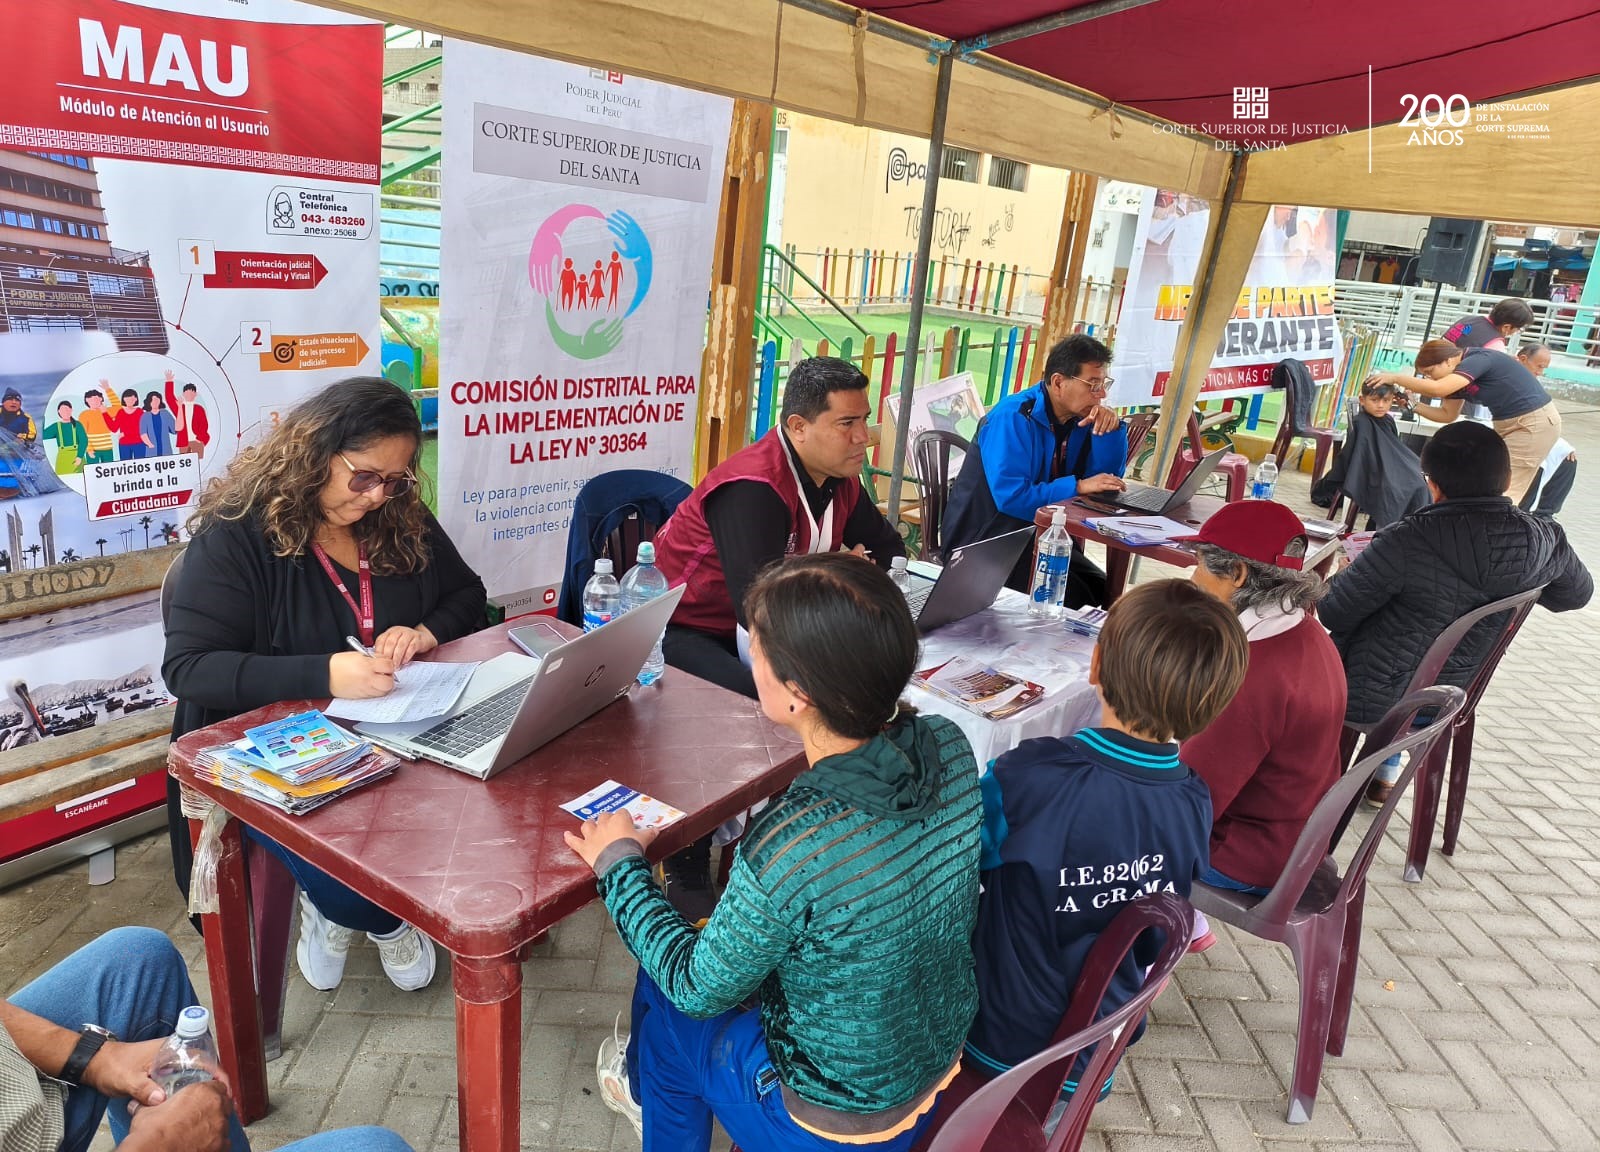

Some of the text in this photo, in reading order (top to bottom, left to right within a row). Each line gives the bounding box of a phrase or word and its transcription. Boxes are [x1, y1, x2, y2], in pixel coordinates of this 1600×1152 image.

[78, 18, 249, 97] MAU
[566, 82, 642, 108] PODER JUDICIAL
[59, 95, 270, 137] Módulo de Atención al Usuario
[481, 120, 701, 171] CORTE SUPERIOR DE JUSTICIA
[559, 159, 640, 185] DEL SANTA
[299, 191, 334, 202] Central
[300, 201, 348, 212] Telefónica
[301, 213, 365, 226] 043- 483260
[190, 245, 200, 265] 1
[240, 258, 288, 269] Orientación
[241, 270, 310, 282] Presencial y Virtual
[10, 289, 89, 302] PODER JUDICIAL
[252, 327, 262, 346] 2
[320, 335, 356, 345] situacional
[1216, 318, 1334, 358] ERANTE
[299, 348, 309, 357] de
[318, 346, 346, 358] procesos
[299, 358, 327, 368] judiciales
[1238, 367, 1259, 384] MÁS
[450, 374, 695, 406] COMISIÓN DISTRITAL PARA
[464, 400, 684, 437] LA IMPLEMENTACIÓN DE
[509, 442, 534, 464] LA
[538, 438, 572, 461] LEY
[599, 432, 648, 455] 30364
[95, 458, 192, 478] Servicios que se
[113, 474, 178, 493] brinda a la
[463, 490, 485, 504] Ley
[488, 488, 517, 504] para
[520, 478, 571, 498] prevenir,
[475, 498, 575, 523] la violencia cont
[493, 521, 560, 541] integrantes
[64, 798, 109, 819] ESCANÉAME
[1058, 854, 1164, 887] I.E.82062
[1055, 896, 1080, 912] A
